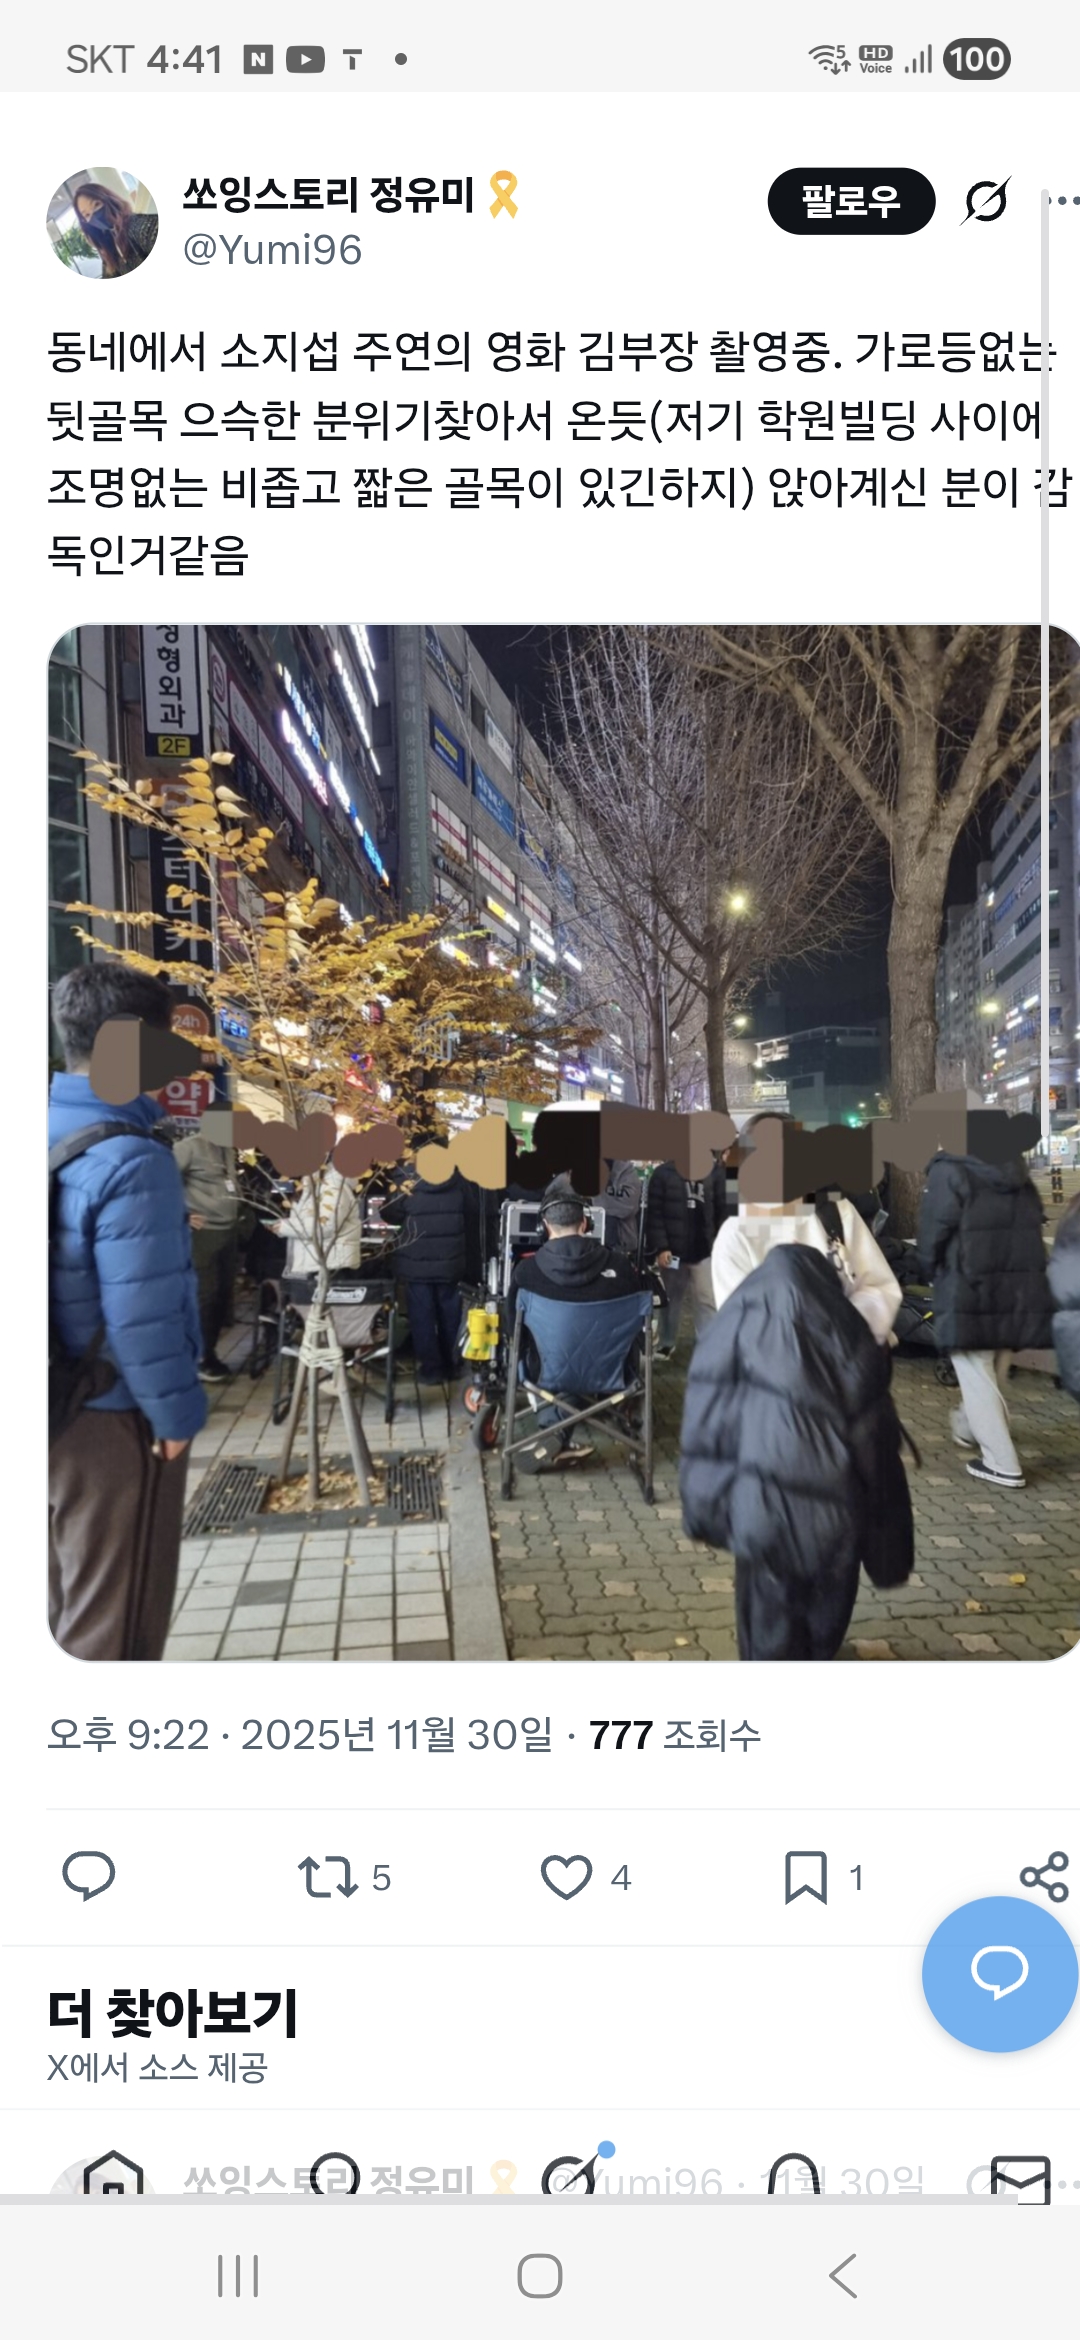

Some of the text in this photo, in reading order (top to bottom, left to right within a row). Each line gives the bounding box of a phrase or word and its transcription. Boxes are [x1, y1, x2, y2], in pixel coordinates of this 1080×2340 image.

[67, 45, 222, 73] SKT 4:41
[859, 62, 893, 73] Voice
[863, 47, 889, 58] HD
[950, 46, 1004, 72] 100
[183, 177, 474, 213] 쏘잉스토리 정유미
[802, 185, 901, 218] 팔로우
[184, 233, 362, 266] @Yumi96
[48, 331, 1057, 373] 동네에서 소지섭 주연의 영화 김부장 촬영중. 가로등없는
[47, 401, 168, 441] 뒷골목
[181, 401, 301, 441] 으슥한
[314, 400, 551, 441] 분위기찾아서
[568, 400, 742, 443] 온듯(저기
[758, 400, 915, 441] 학원빌딩
[48, 467, 1073, 511] 조명없는 비좁고 짧은 골목이 있긴하지) 앉아계신 분이 감
[48, 536, 249, 576] 독인거같음
[161, 737, 187, 754] 2F
[172, 1013, 201, 1028] 24h
[166, 1081, 202, 1115] 약
[48, 1717, 762, 1752] 오후 9:22 2025년 11월 30일 777 조회수
[373, 1865, 391, 1892] 5
[611, 1865, 632, 1891] 4
[850, 1865, 862, 1891] 1
[49, 1989, 297, 2038] 더 찾아보기
[47, 2051, 268, 2084] X에서 소스 제공
